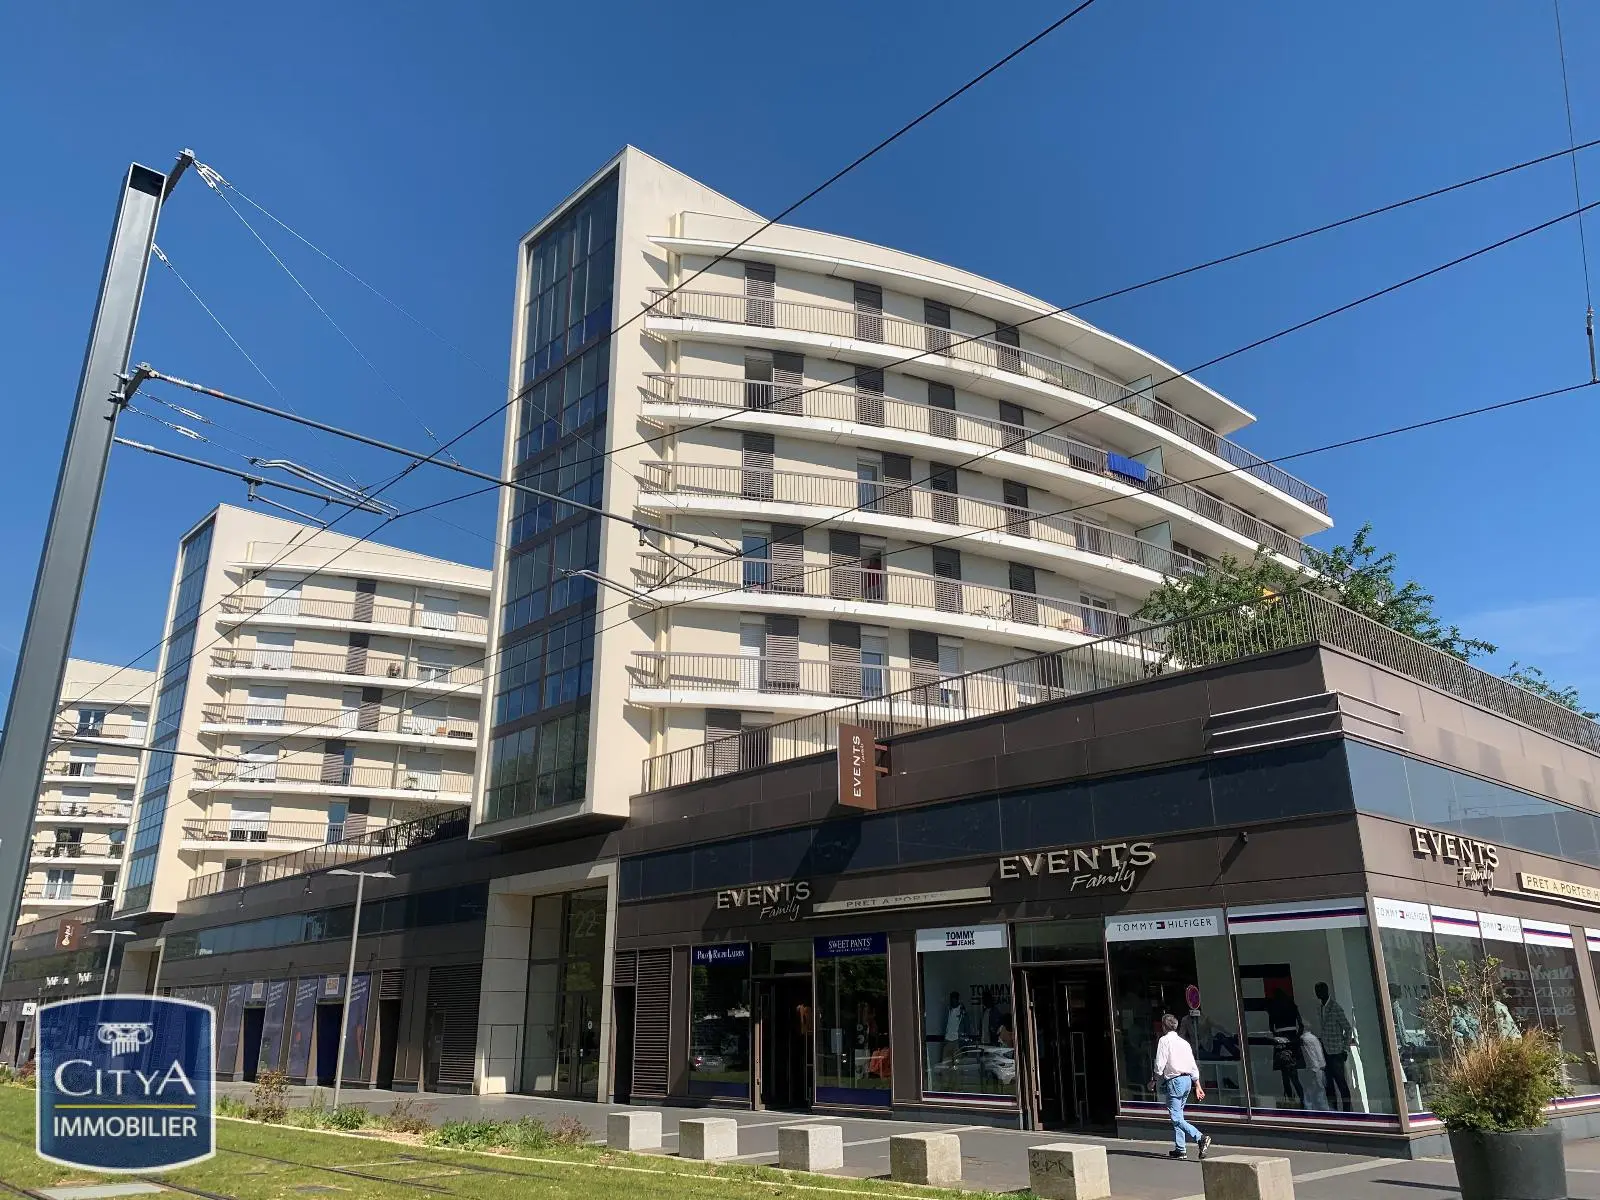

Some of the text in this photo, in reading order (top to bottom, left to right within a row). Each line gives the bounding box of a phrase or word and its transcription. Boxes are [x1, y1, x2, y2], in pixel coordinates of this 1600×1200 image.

[852, 735, 862, 797] EVENTS
[999, 842, 1157, 879] EVENTS
[1413, 827, 1500, 868] EVENTS
[1070, 861, 1136, 892] Family
[1462, 860, 1495, 891] Family
[1526, 876, 1549, 890] PRET
[1552, 881, 1559, 891] A
[1560, 882, 1593, 898] PORTER
[717, 881, 811, 909] EVENTS
[846, 900, 877, 908] PRET
[760, 896, 800, 921] Family
[945, 930, 975, 940] TOMMY
[1117, 919, 1212, 931] TOMMY HILFIGER
[828, 938, 871, 949] SWEET PANTS
